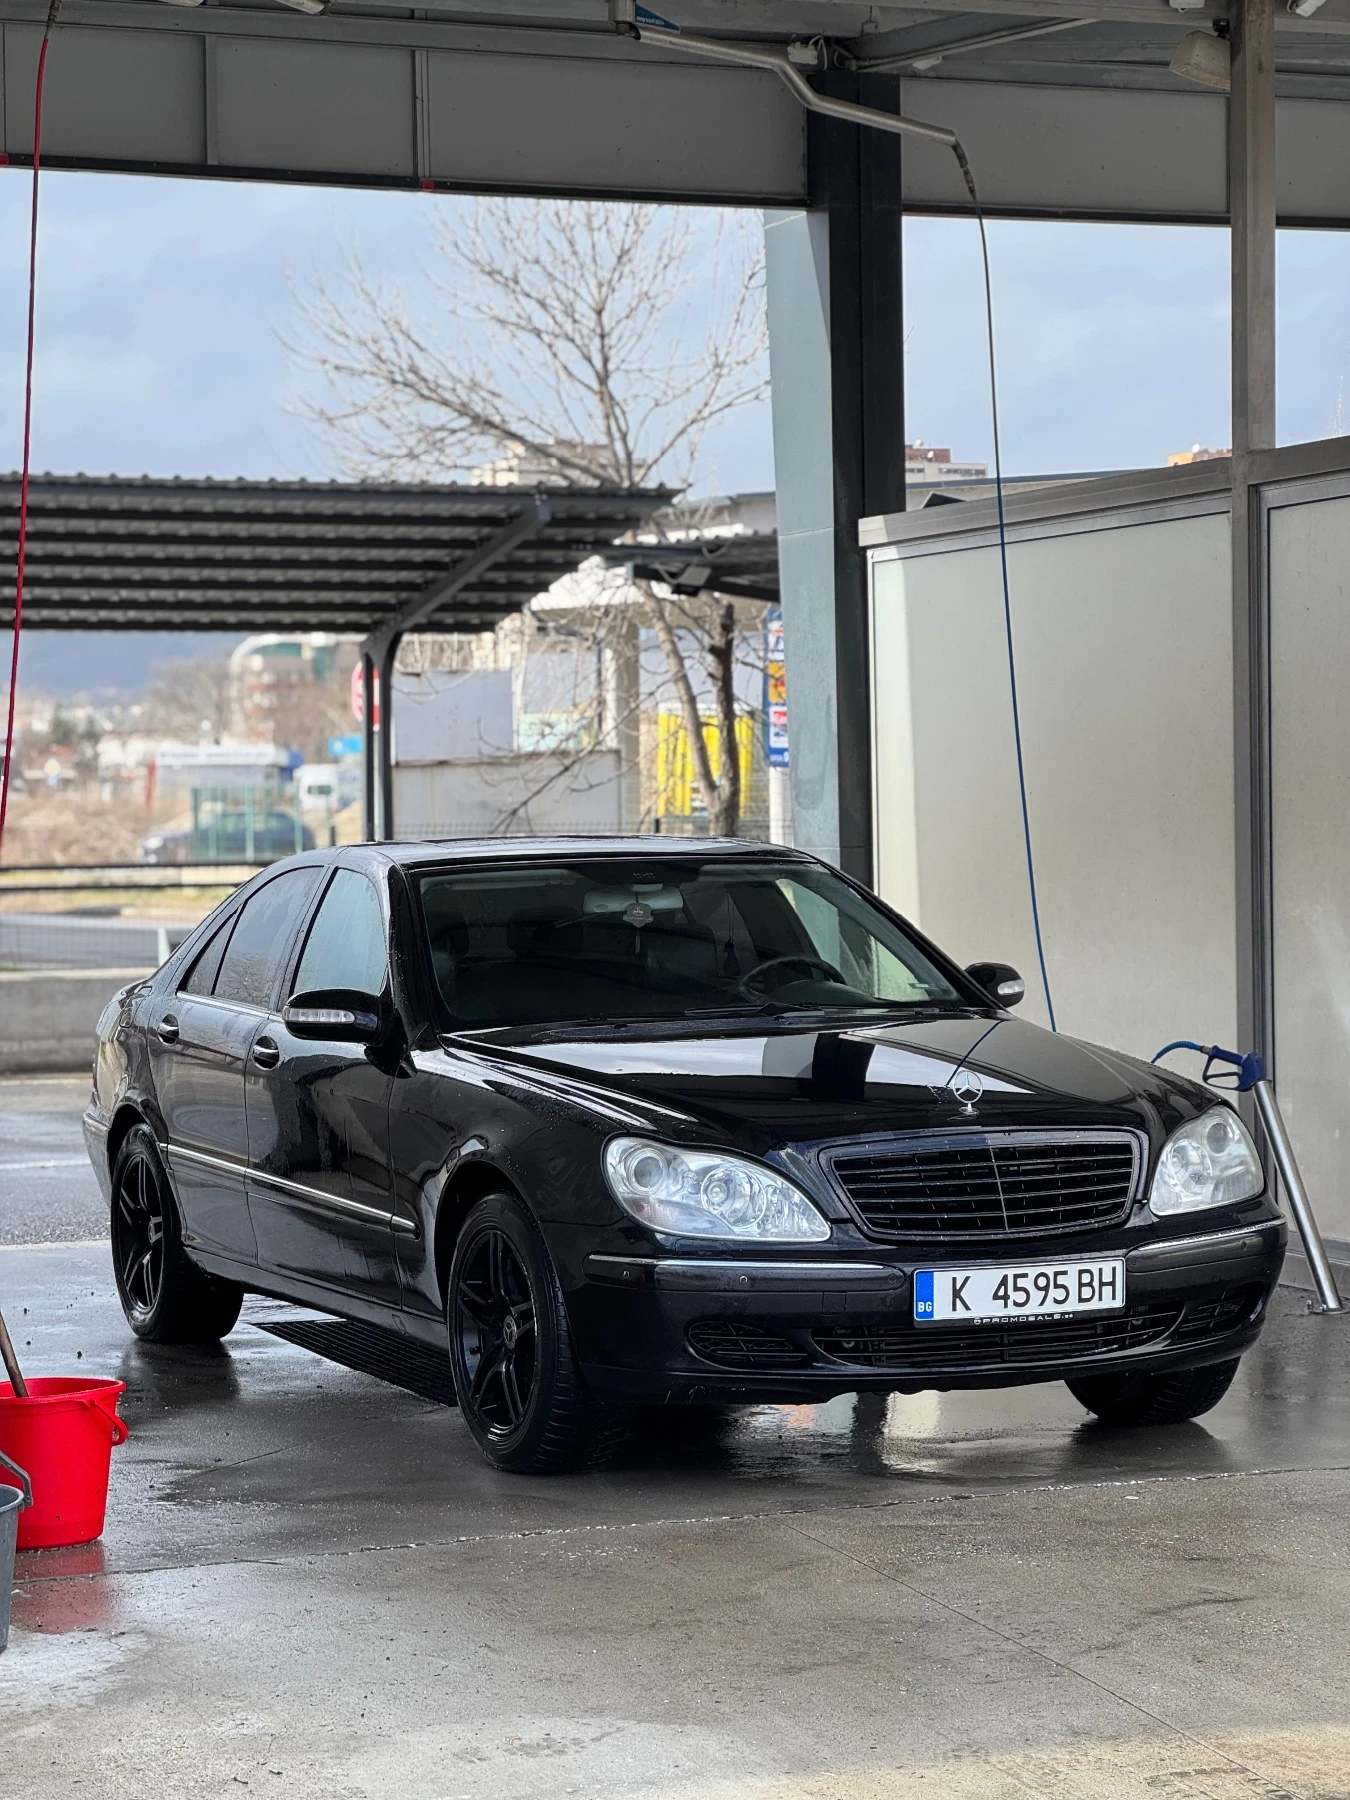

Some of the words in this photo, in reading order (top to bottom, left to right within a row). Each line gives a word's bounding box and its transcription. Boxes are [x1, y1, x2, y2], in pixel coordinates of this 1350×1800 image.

[951, 1275, 972, 1312] K
[992, 1270, 1071, 1309] 4595
[1077, 1266, 1117, 1304] BH
[917, 1301, 933, 1313] BG
